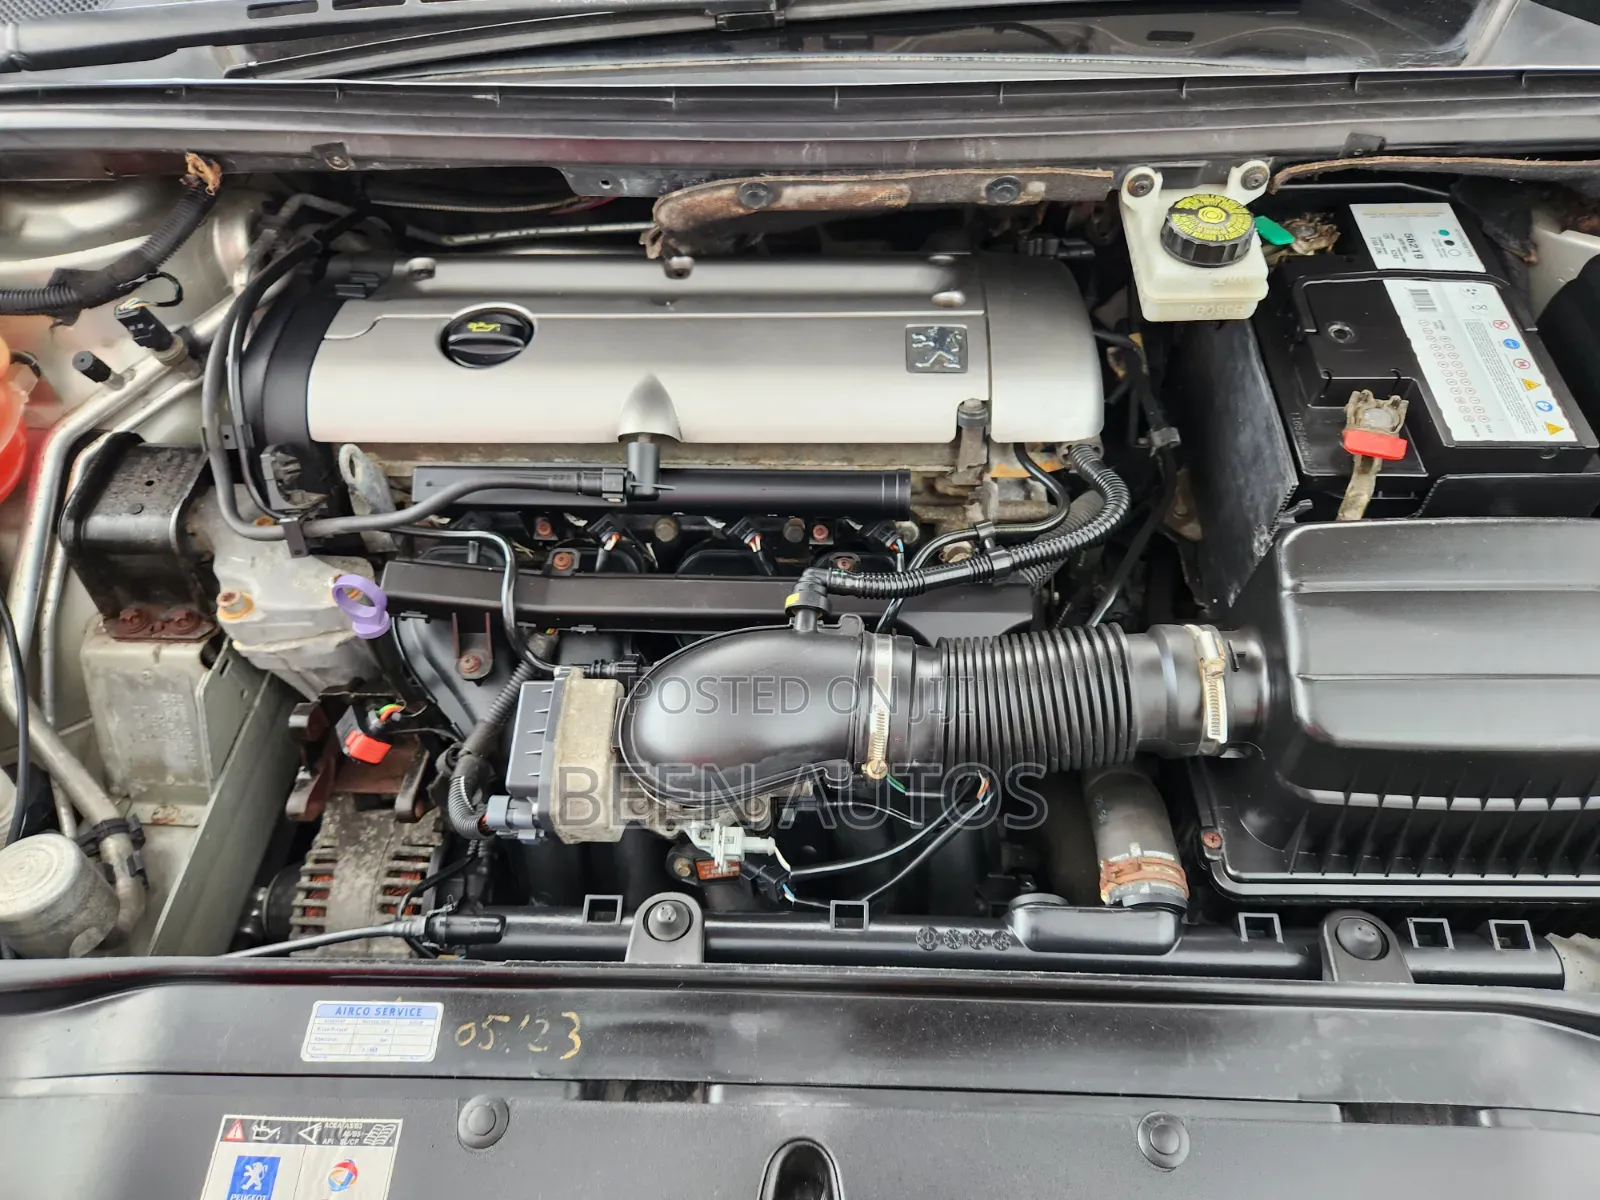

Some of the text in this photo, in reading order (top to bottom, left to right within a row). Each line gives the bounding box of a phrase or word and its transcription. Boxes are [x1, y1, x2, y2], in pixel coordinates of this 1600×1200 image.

[1195, 303, 1245, 317] BOSCH
[335, 1005, 423, 1018] AIRCO SERVICE
